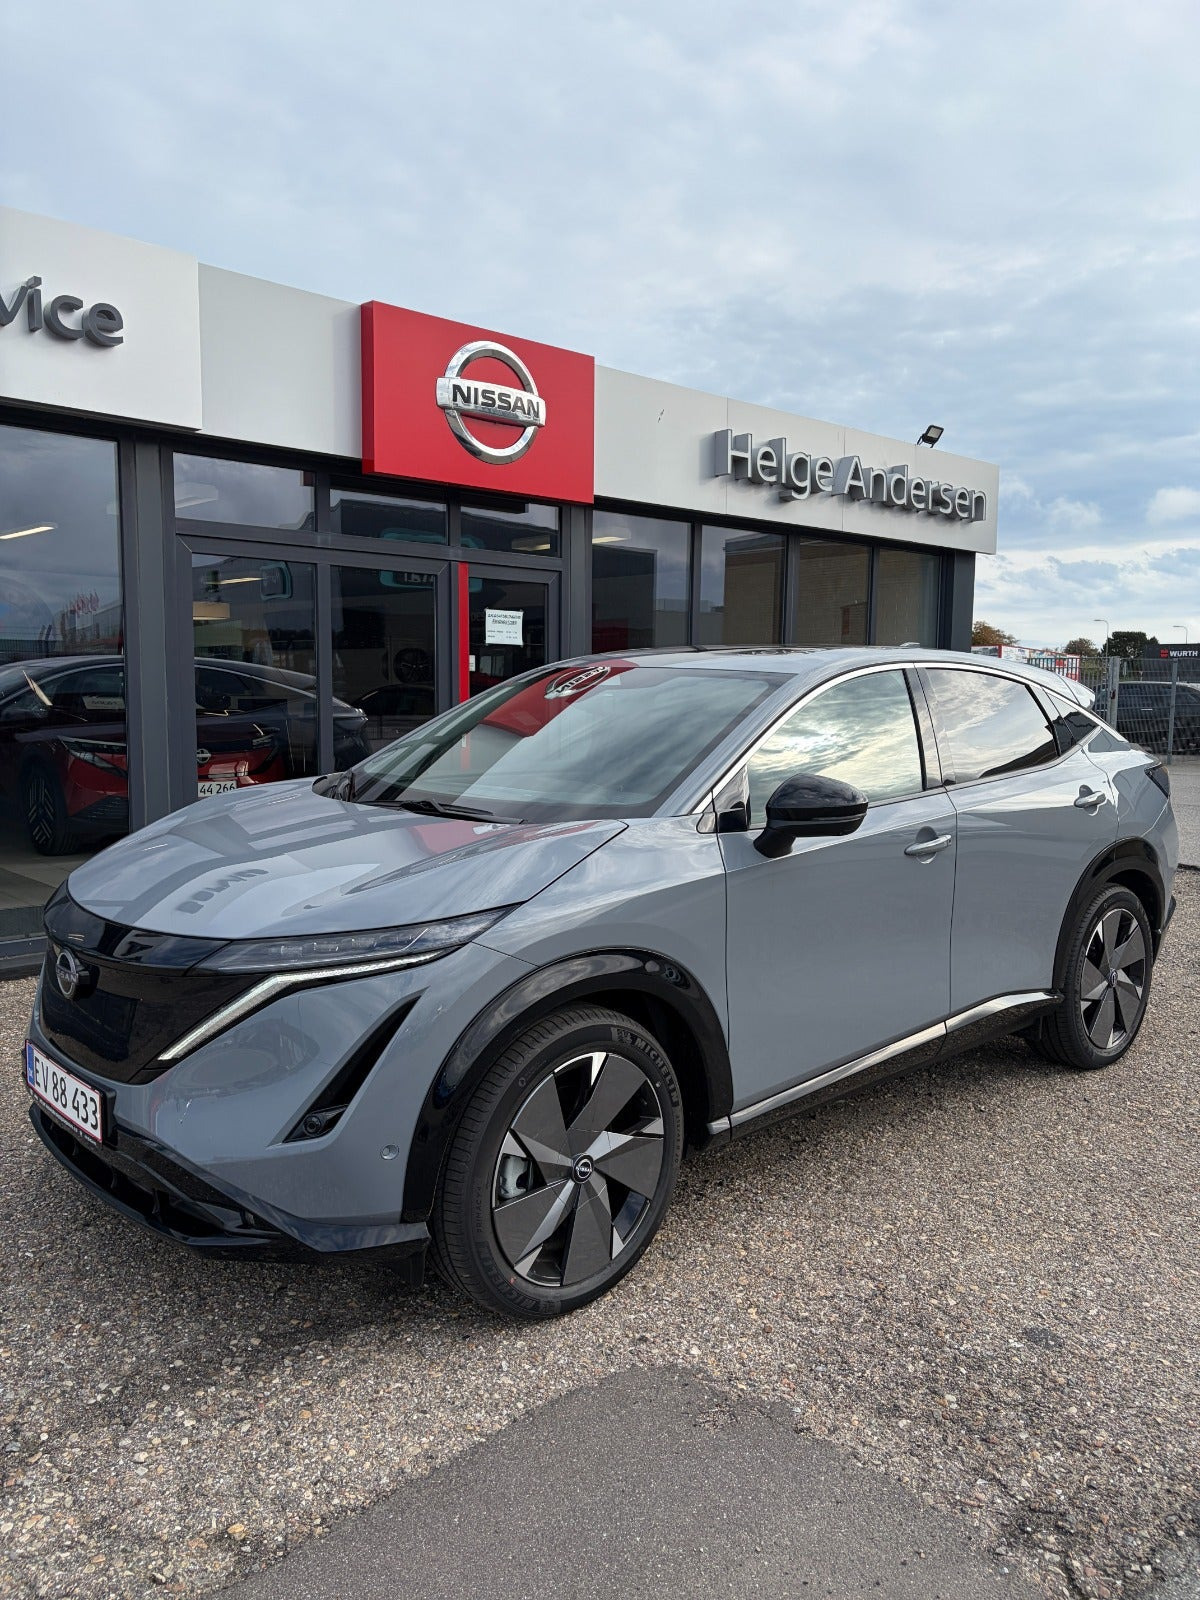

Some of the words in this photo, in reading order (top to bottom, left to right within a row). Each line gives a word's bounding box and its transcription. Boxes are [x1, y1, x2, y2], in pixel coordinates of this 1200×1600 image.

[0, 276, 123, 347] vice
[452, 384, 540, 418] NISSAN
[715, 429, 834, 500] Helge
[836, 455, 987, 521] Andersen
[200, 784, 213, 795] 44
[35, 1056, 48, 1093] EV
[53, 1071, 68, 1109] 88
[72, 1087, 99, 1130] 433
[635, 1037, 679, 1103] MICHELIN
